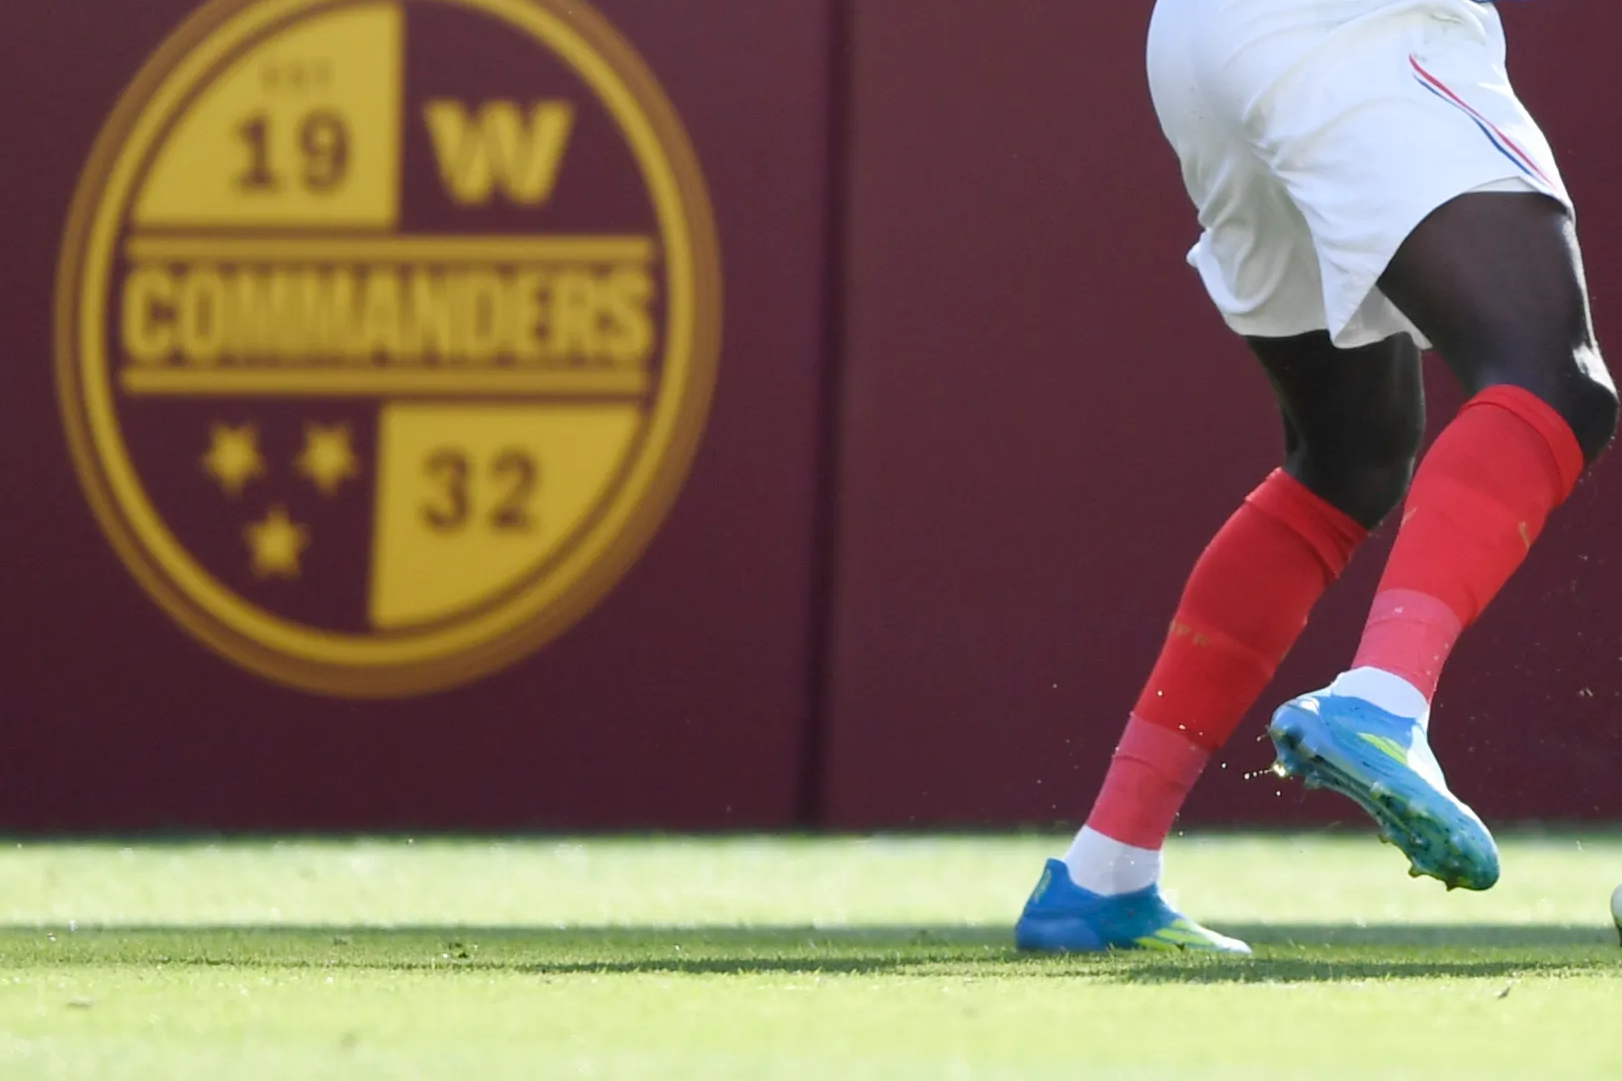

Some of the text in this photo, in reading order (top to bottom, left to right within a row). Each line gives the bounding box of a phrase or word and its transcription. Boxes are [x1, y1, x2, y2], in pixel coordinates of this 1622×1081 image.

[234, 106, 354, 195] 19
[424, 99, 574, 206] W
[124, 269, 652, 359] COMMANDERS
[421, 443, 541, 536] 32
